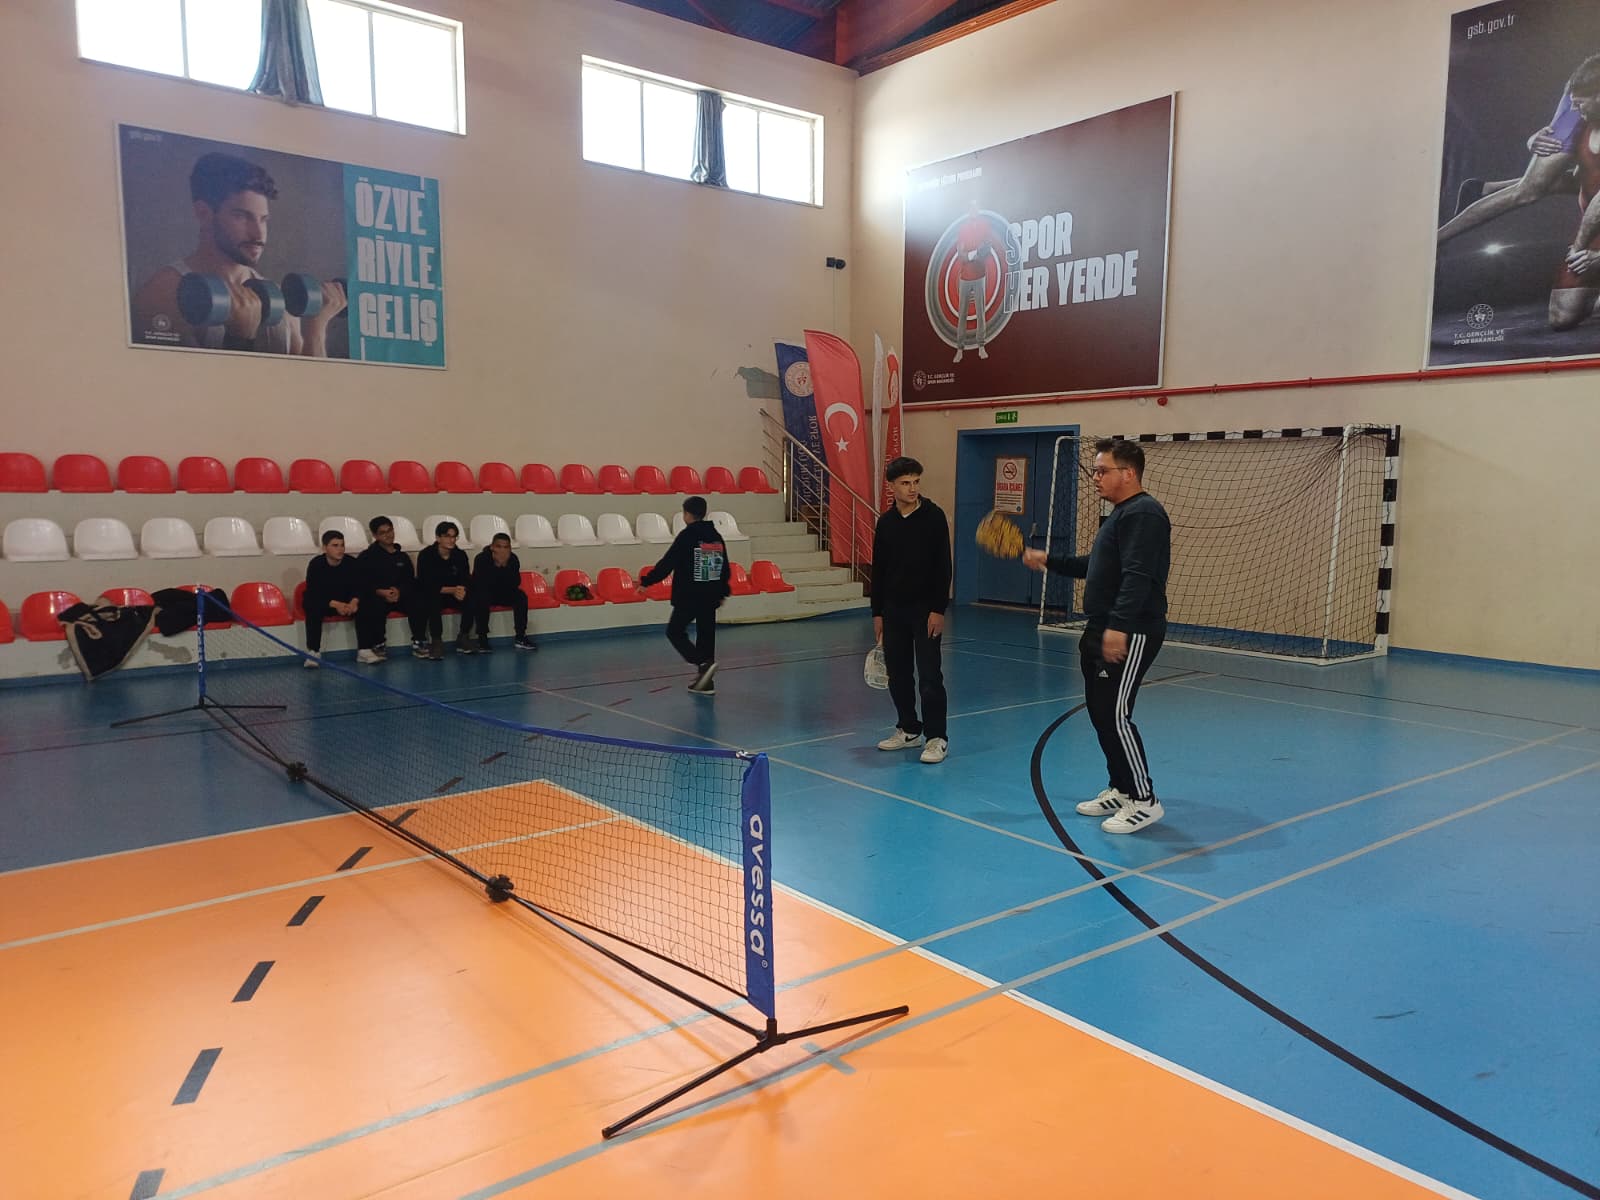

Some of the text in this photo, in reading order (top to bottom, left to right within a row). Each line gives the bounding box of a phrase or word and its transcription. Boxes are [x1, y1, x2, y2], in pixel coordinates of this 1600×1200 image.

[1467, 14, 1516, 40] gsb.gov.tr
[355, 176, 427, 236] ÖZVE
[357, 235, 436, 290] RİYLE
[1006, 211, 1073, 266] SPOR
[1003, 249, 1139, 314] HER YERDE
[358, 292, 438, 347] GELİŞ
[750, 814, 765, 957] avessa
